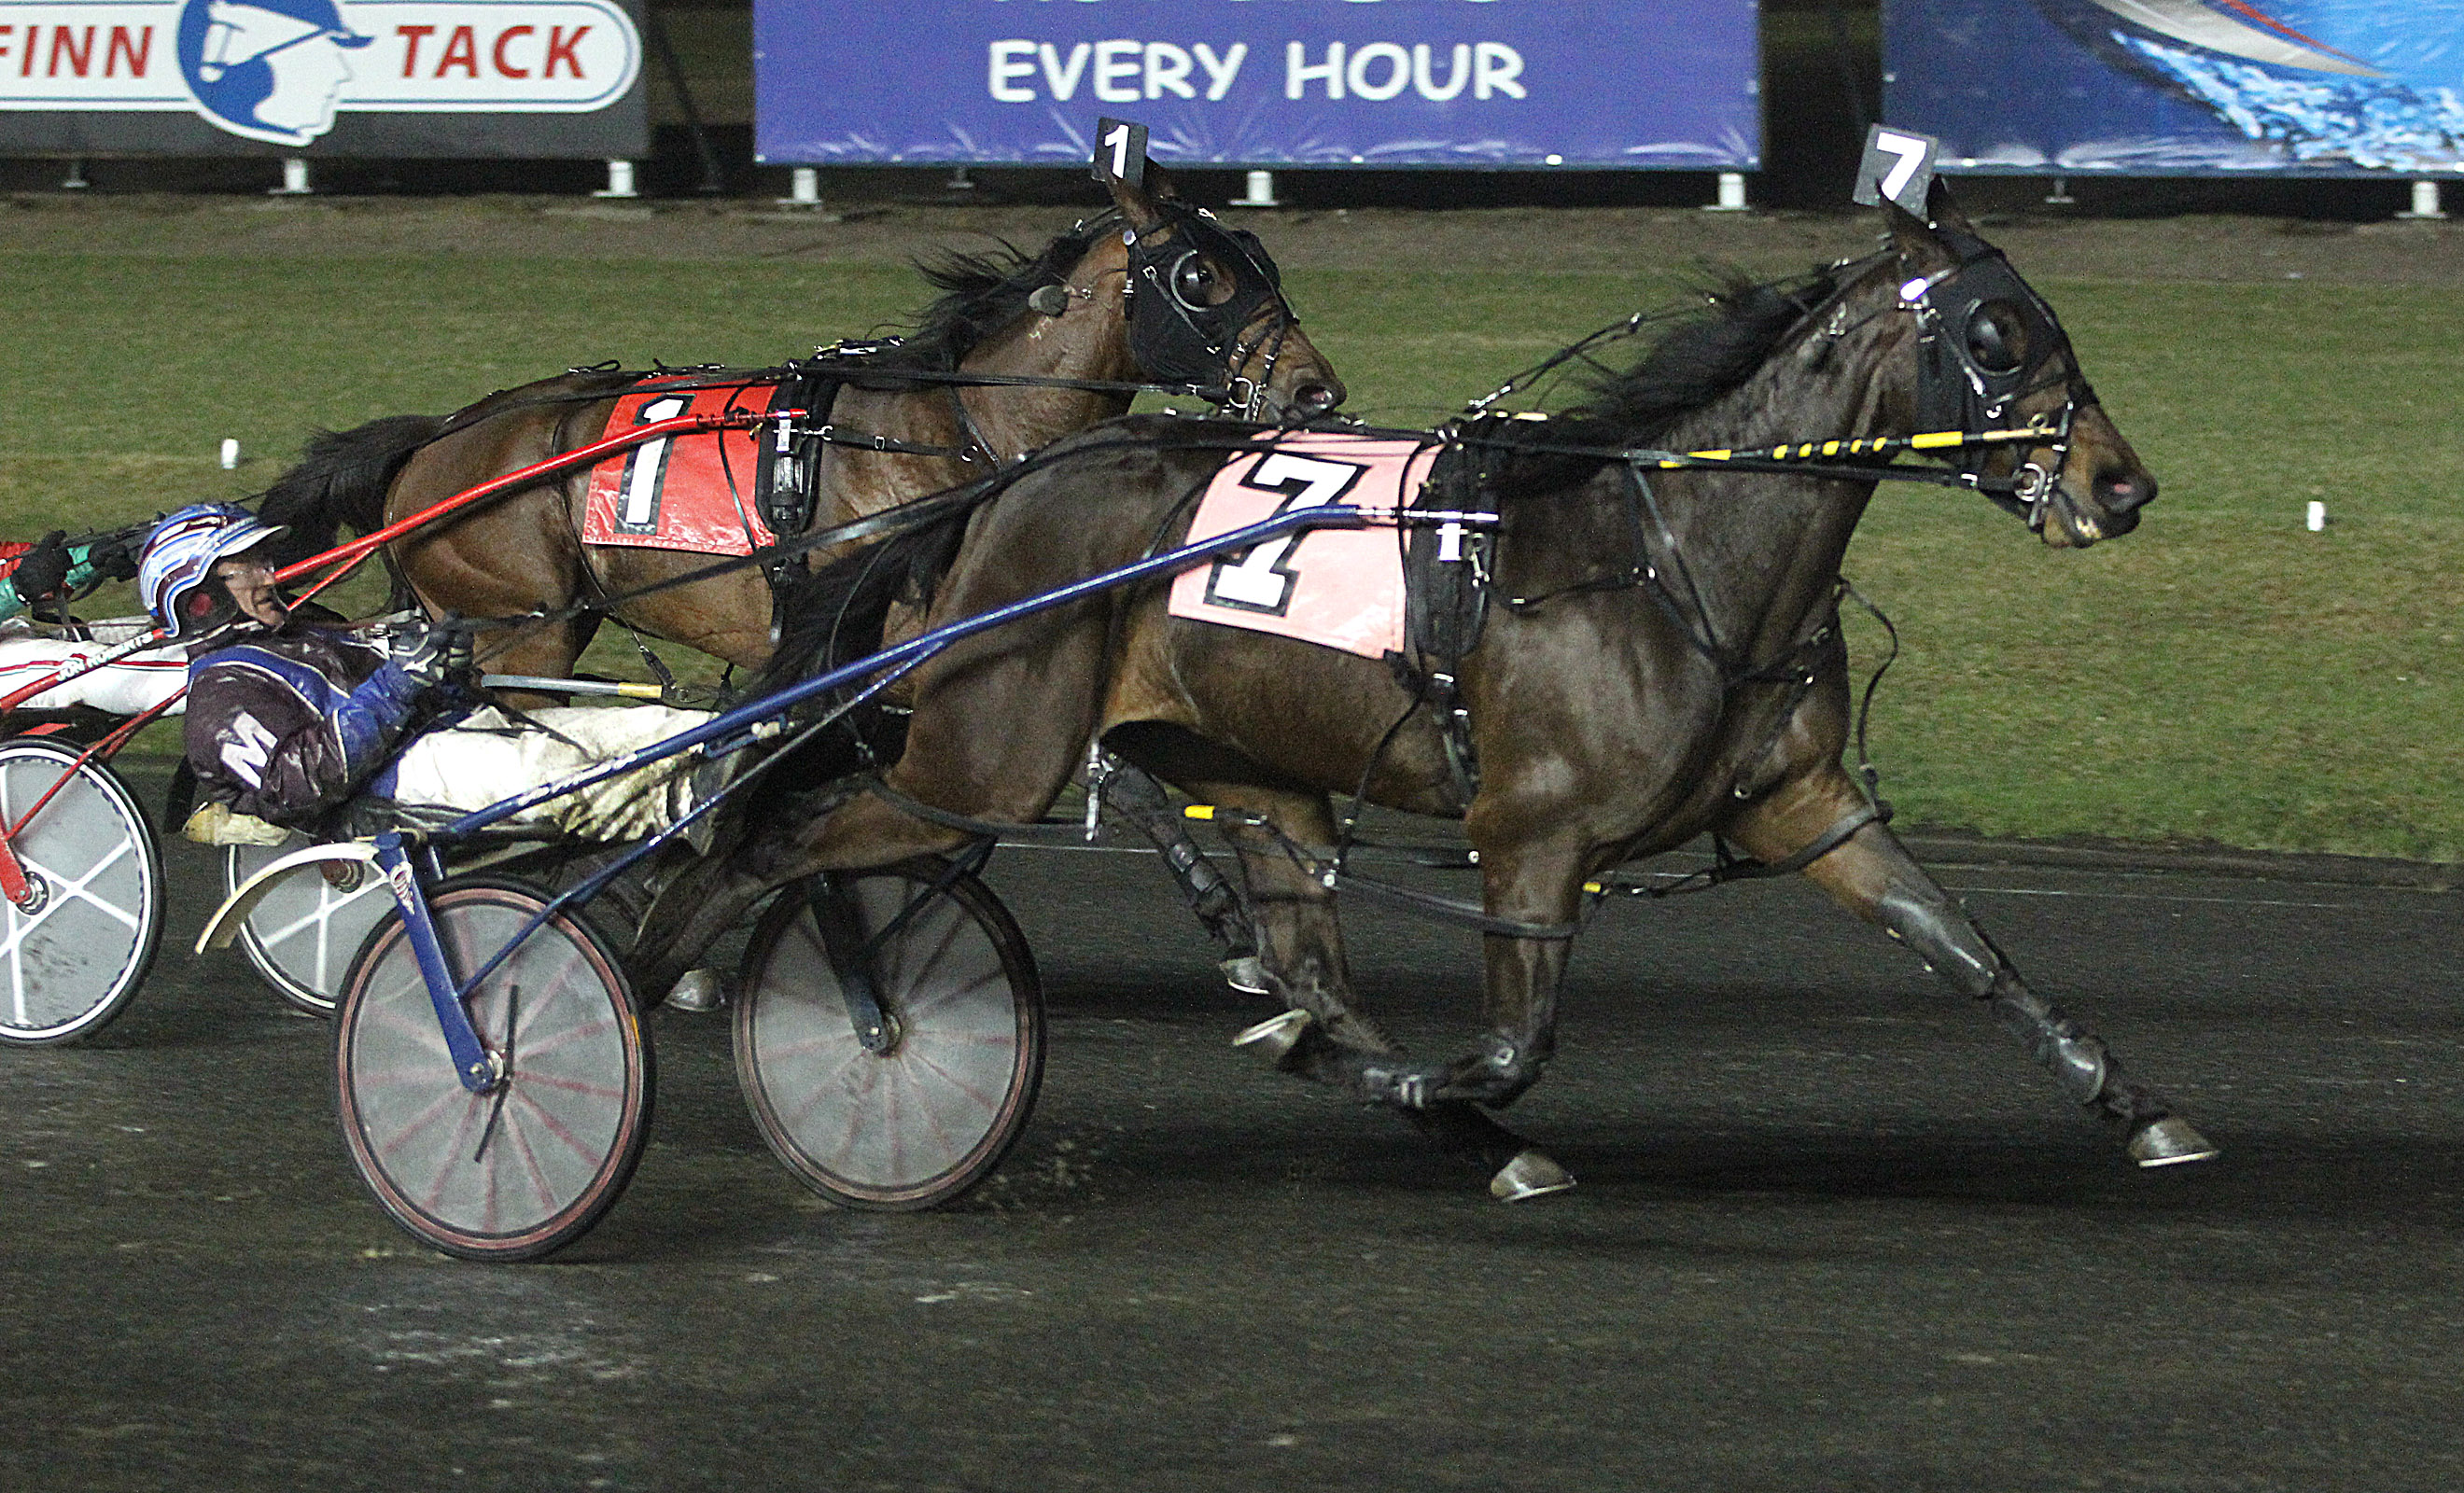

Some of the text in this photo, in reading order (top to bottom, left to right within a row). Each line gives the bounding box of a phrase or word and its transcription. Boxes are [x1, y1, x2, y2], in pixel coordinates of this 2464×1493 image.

[396, 24, 593, 78] TACK
[988, 39, 1527, 103] EVERY HOUR
[1104, 124, 1129, 179] 1
[1876, 132, 1927, 202] 7
[617, 394, 693, 532] 1
[1207, 452, 1366, 612] 7
[219, 710, 279, 789] M
